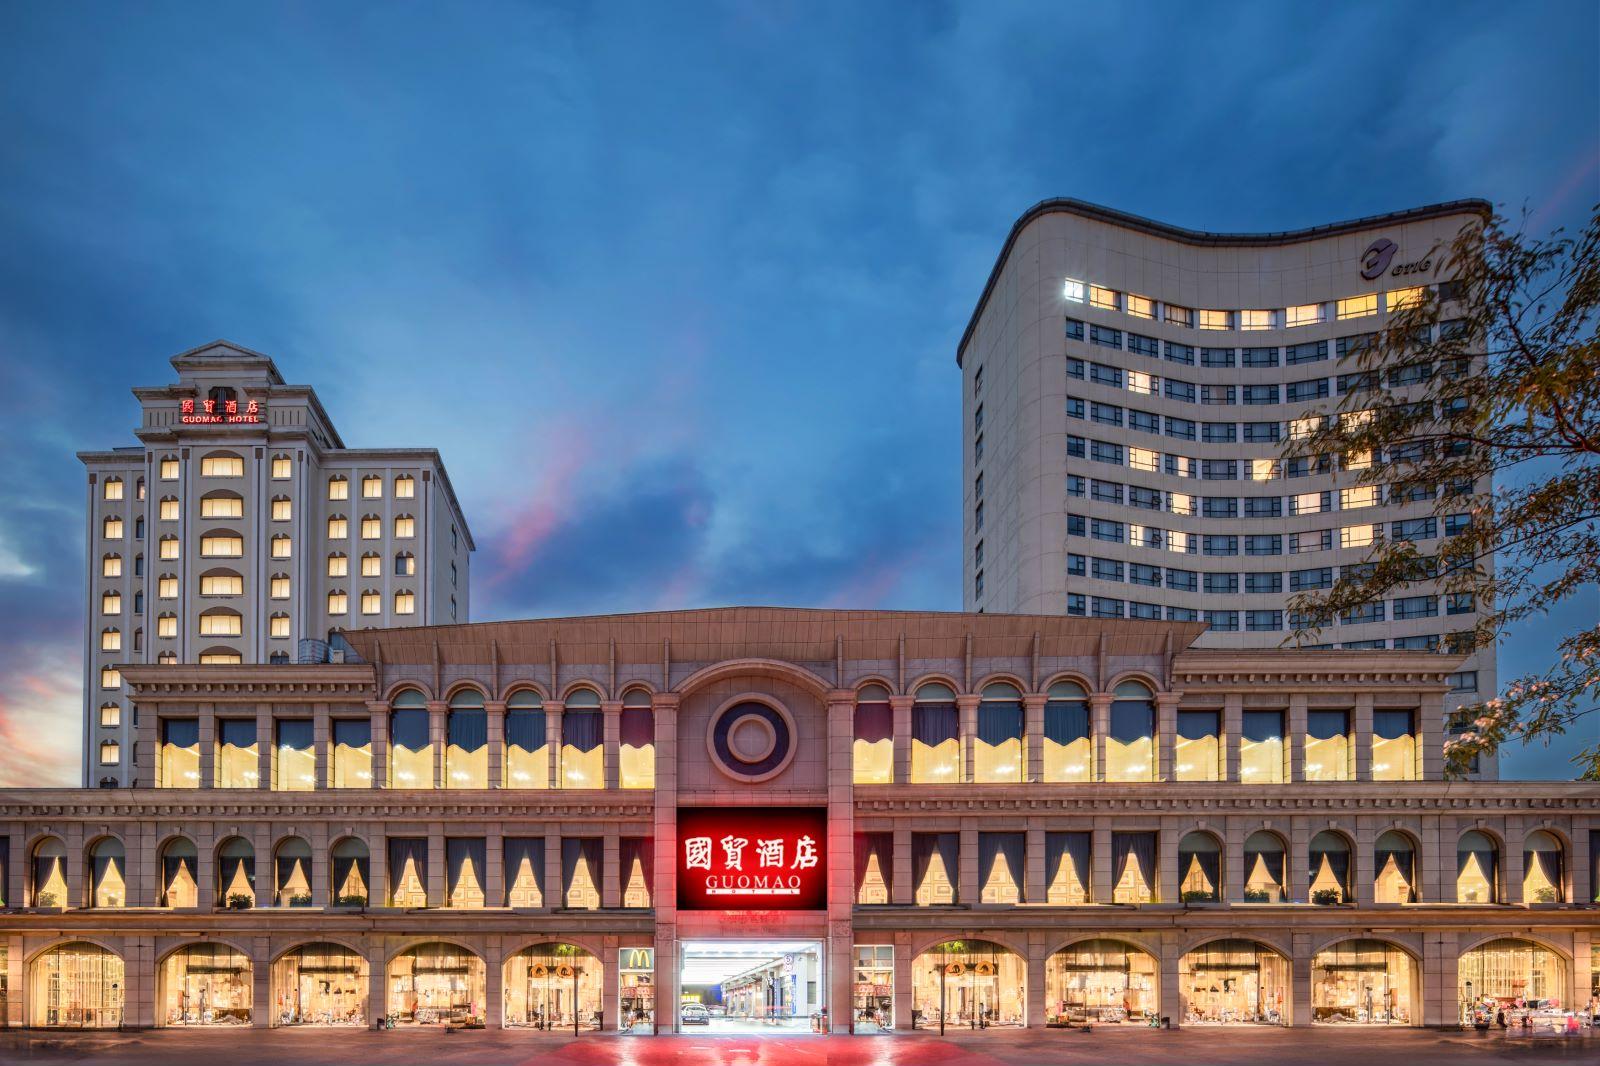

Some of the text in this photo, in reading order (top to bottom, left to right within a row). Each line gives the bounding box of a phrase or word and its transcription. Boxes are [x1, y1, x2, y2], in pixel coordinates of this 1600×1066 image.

[229, 415, 259, 423] HOTEL
[685, 834, 819, 871] 國貿酒店
[706, 875, 801, 889] GUOMAO
